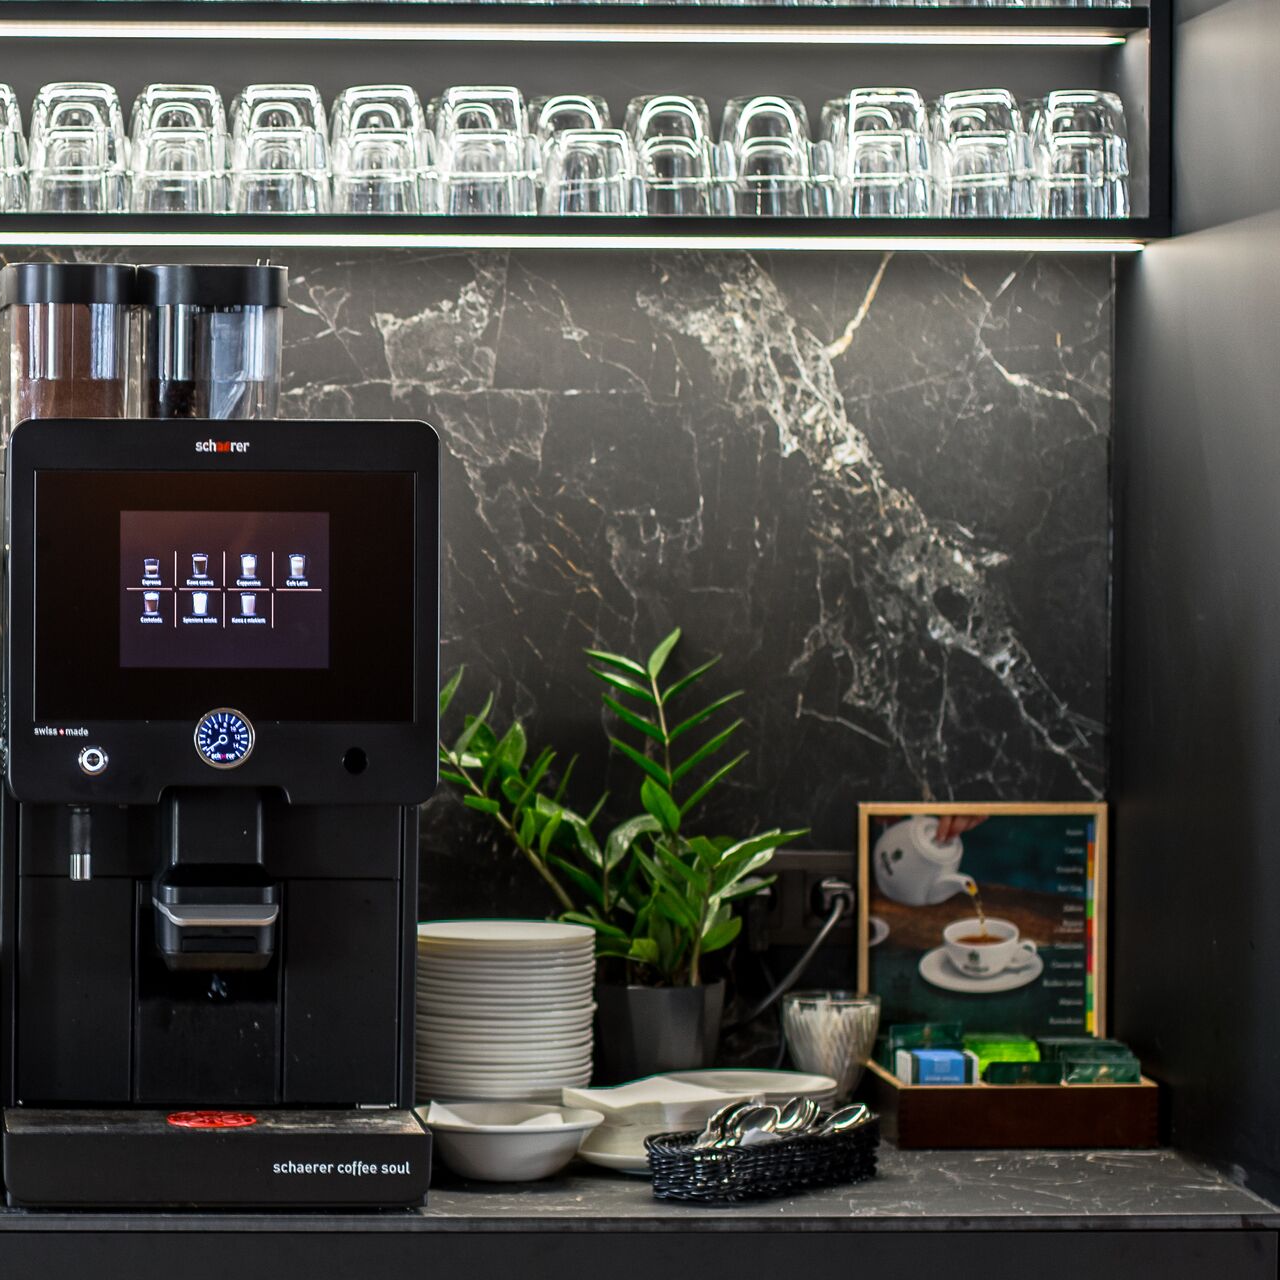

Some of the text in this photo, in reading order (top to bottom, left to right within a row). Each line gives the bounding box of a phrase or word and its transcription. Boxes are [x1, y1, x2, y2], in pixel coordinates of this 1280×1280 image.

[34, 725, 89, 737] swiss made
[273, 1160, 410, 1176] schaerer coffee soul
